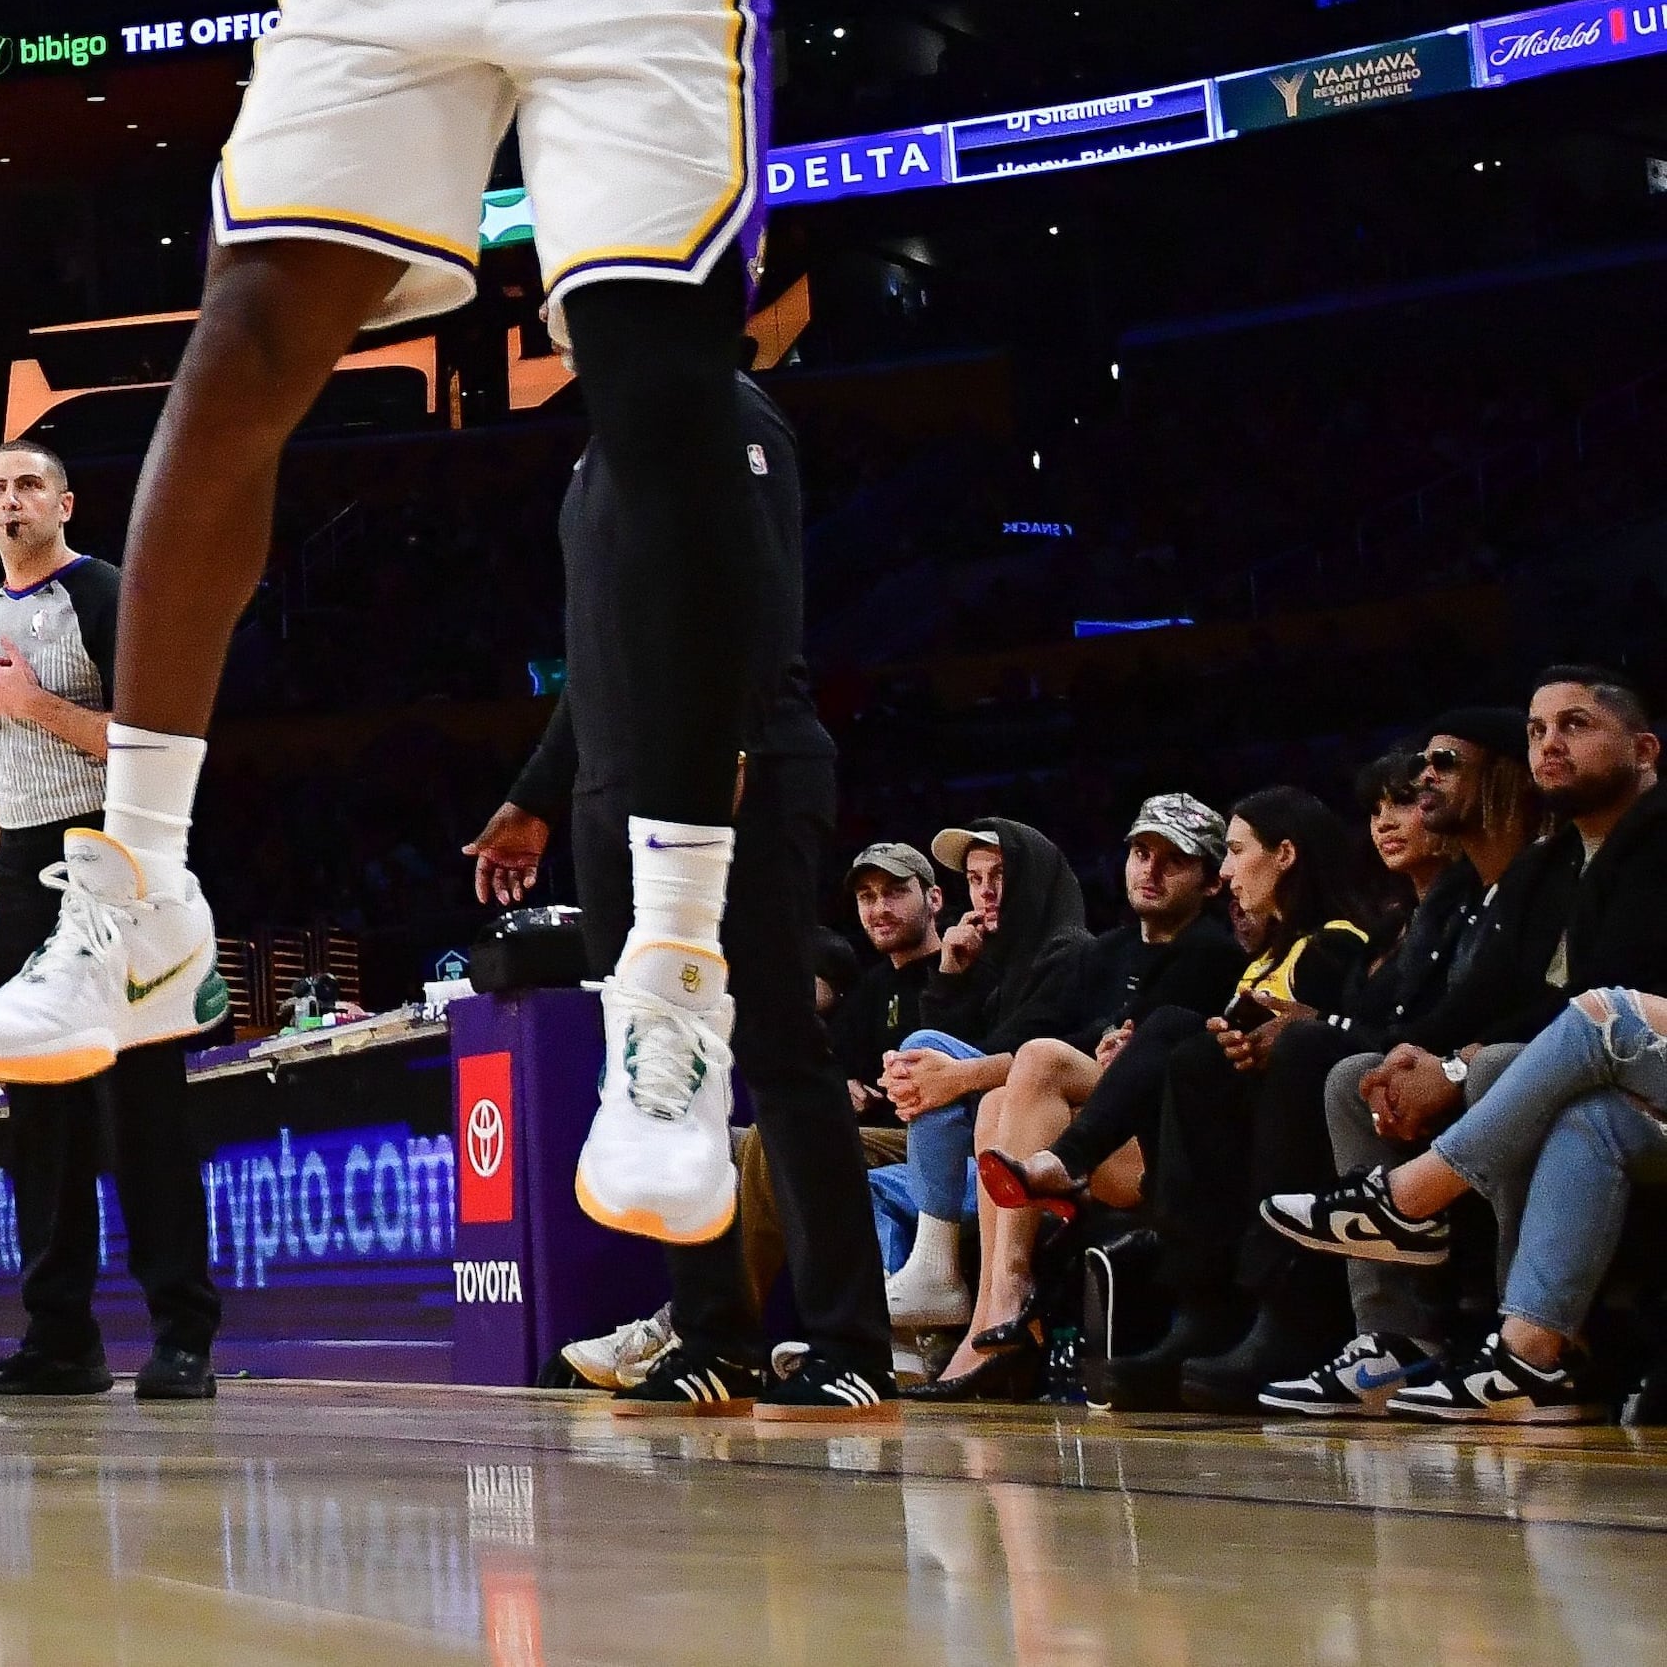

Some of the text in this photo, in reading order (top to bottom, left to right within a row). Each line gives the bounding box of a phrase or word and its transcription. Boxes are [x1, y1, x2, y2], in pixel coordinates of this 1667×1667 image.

[20, 33, 106, 66] bibigo
[121, 22, 186, 52] THE
[1490, 18, 1604, 66] Michelob
[1313, 80, 1361, 99] RESORT
[1372, 68, 1421, 88] CASINO
[1333, 93, 1359, 107] SAN
[1362, 83, 1412, 103] MANUEL
[767, 142, 930, 194] DELTA
[452, 1259, 524, 1304] TOYOTA
